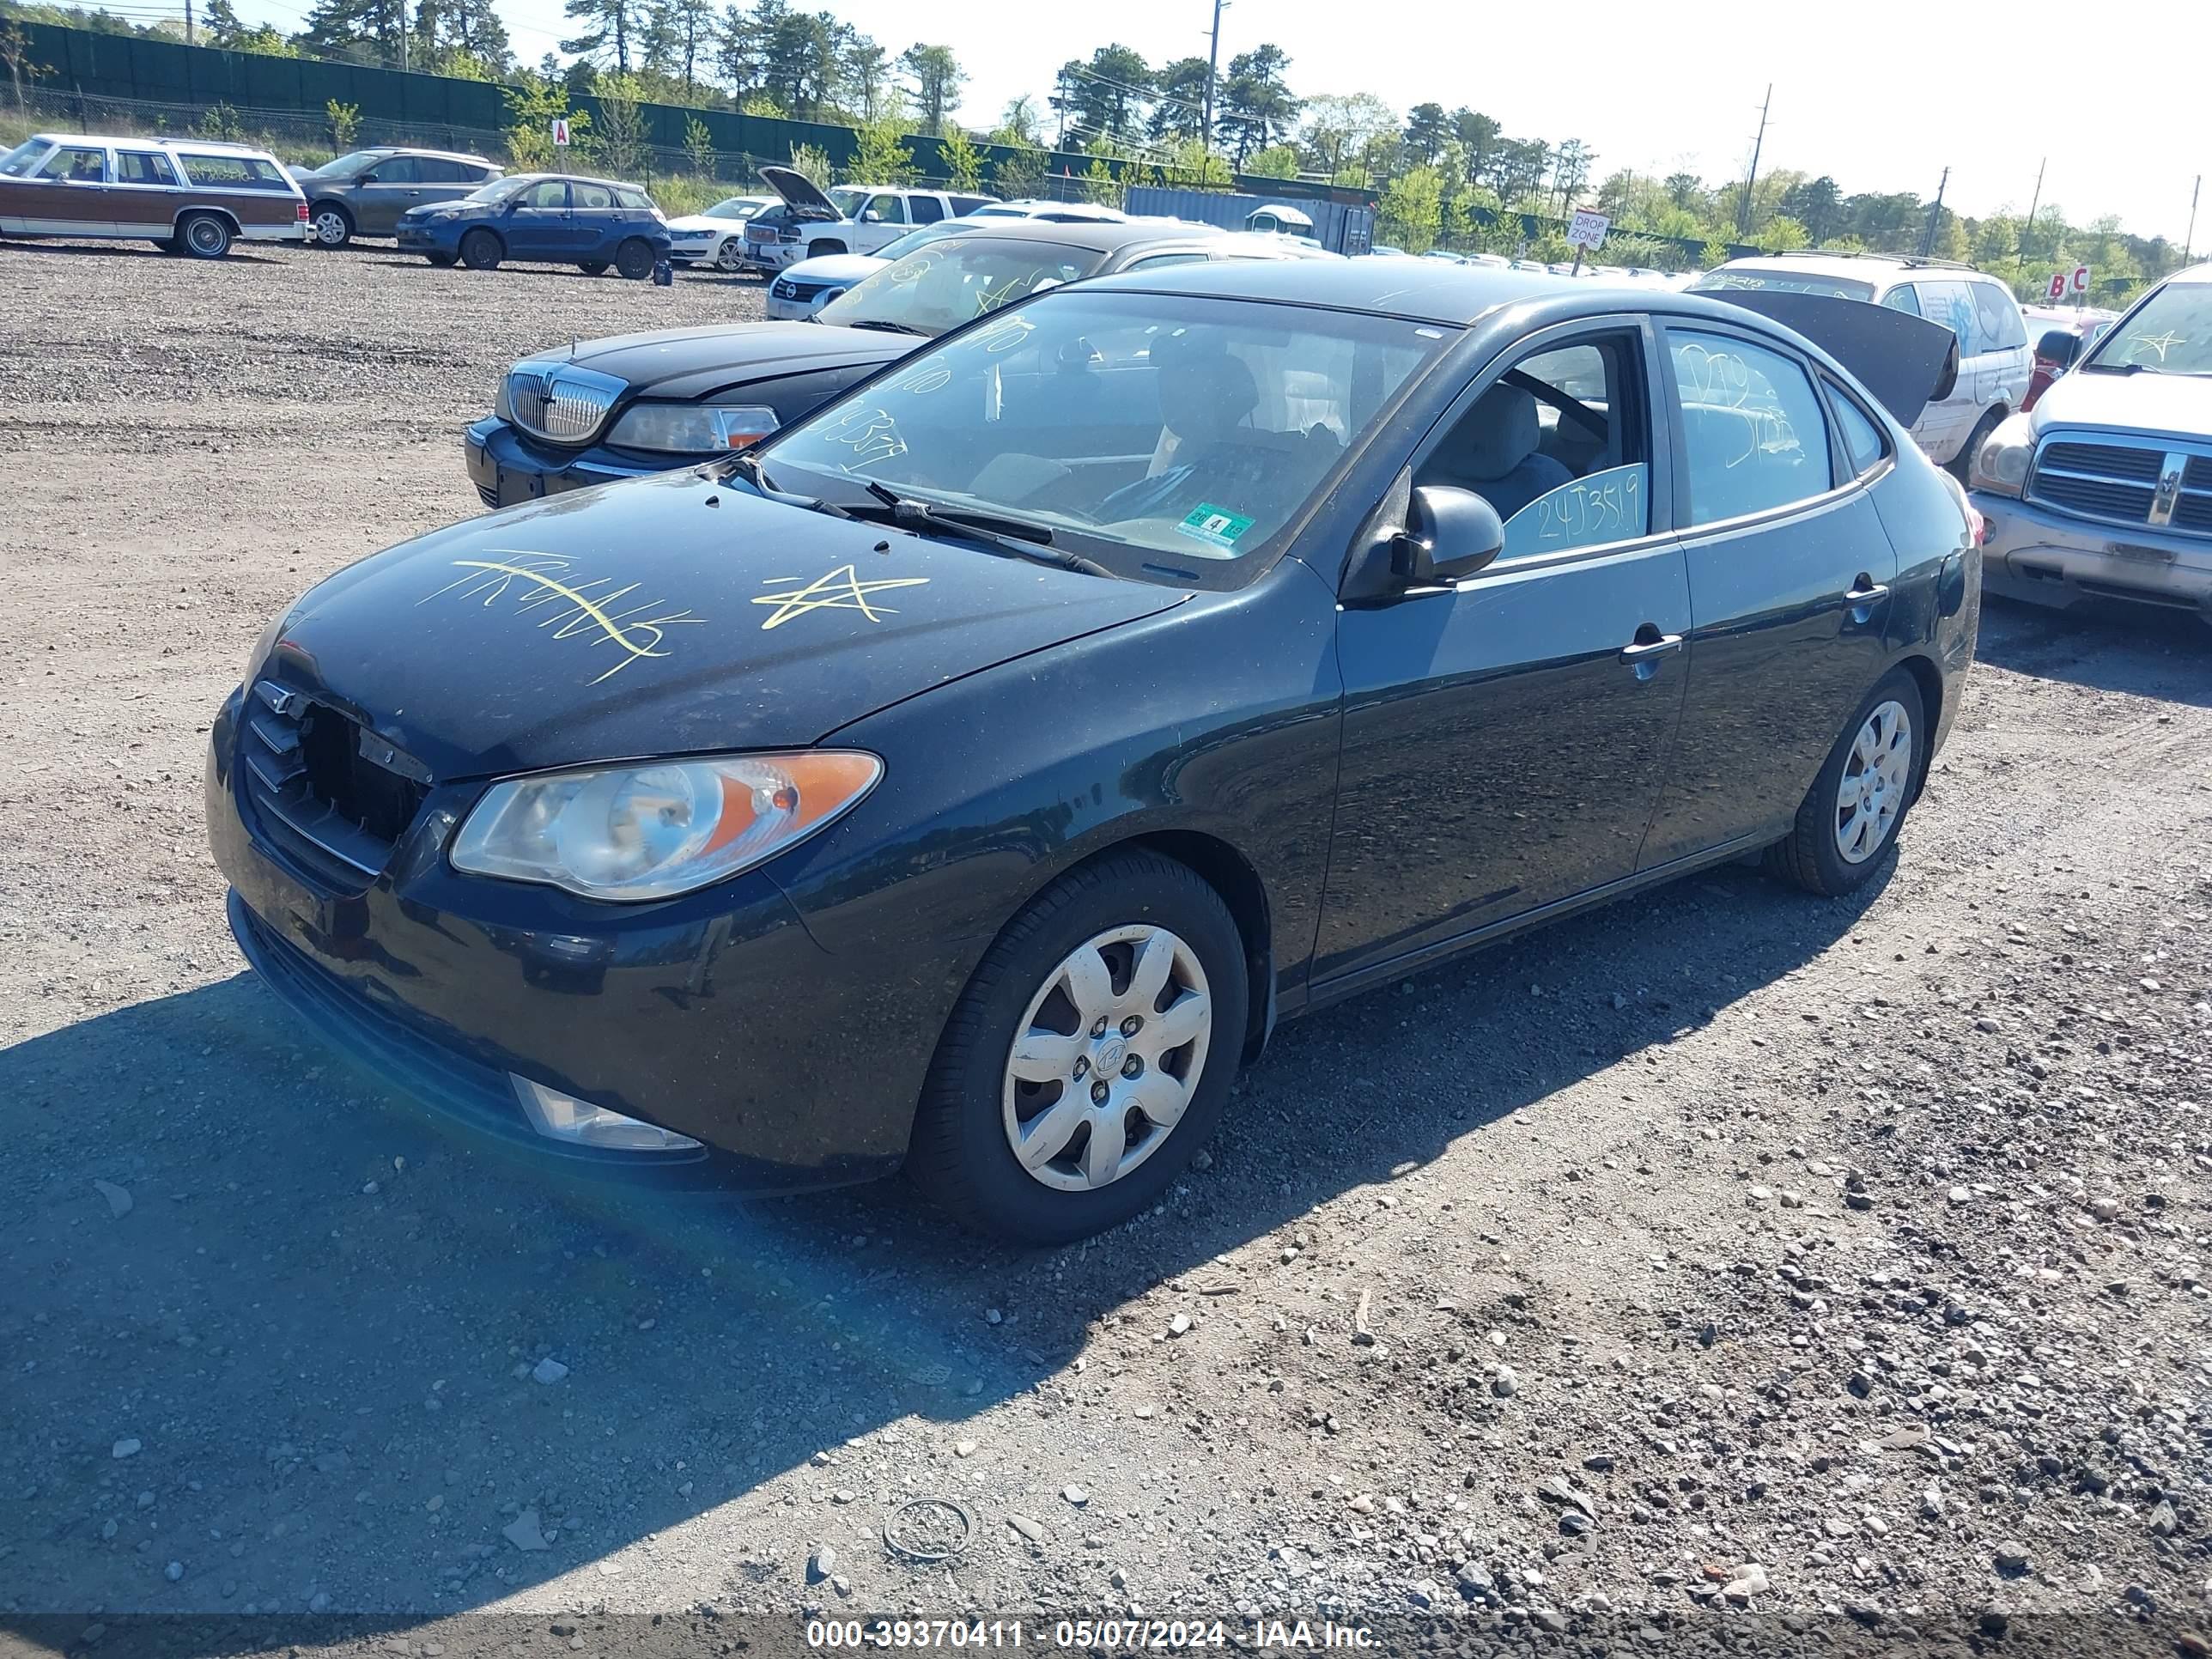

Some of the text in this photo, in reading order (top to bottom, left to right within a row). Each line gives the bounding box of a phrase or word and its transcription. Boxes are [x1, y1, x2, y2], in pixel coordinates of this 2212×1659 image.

[557, 121, 567, 143] A
[1575, 216, 1605, 231] DROP
[1571, 228, 1600, 244] ZONE
[2049, 275, 2065, 297] B
[2074, 268, 2087, 290] C
[1209, 519, 1222, 531] 4
